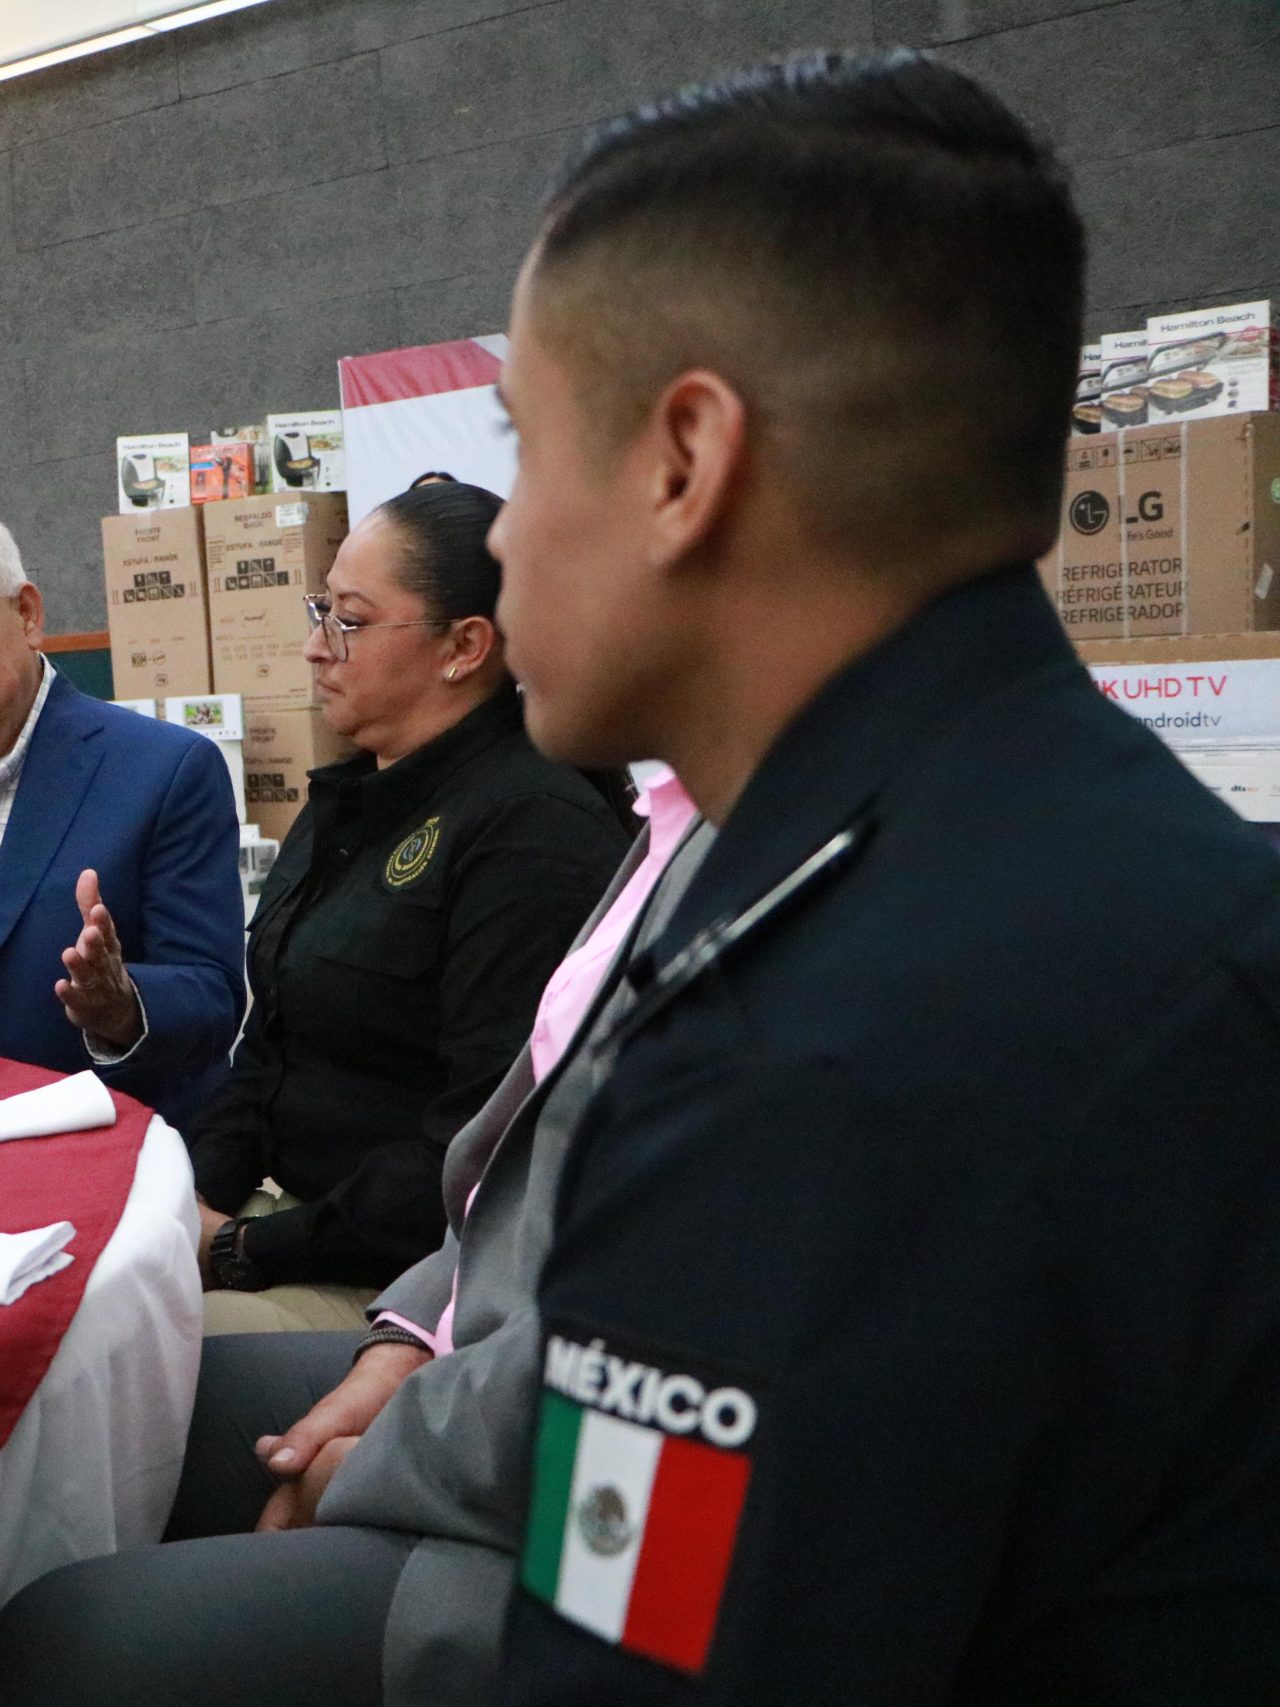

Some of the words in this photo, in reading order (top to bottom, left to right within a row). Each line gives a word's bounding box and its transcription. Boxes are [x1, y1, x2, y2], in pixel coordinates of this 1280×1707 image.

[1161, 318, 1215, 333] Hamilton
[1216, 312, 1256, 326] Beach
[1118, 490, 1164, 524] LG
[1146, 527, 1174, 540] Good
[1095, 679, 1120, 700] K
[1123, 677, 1183, 700] UHD
[1185, 675, 1228, 697] TV
[543, 1334, 758, 1448] MÉXICO
